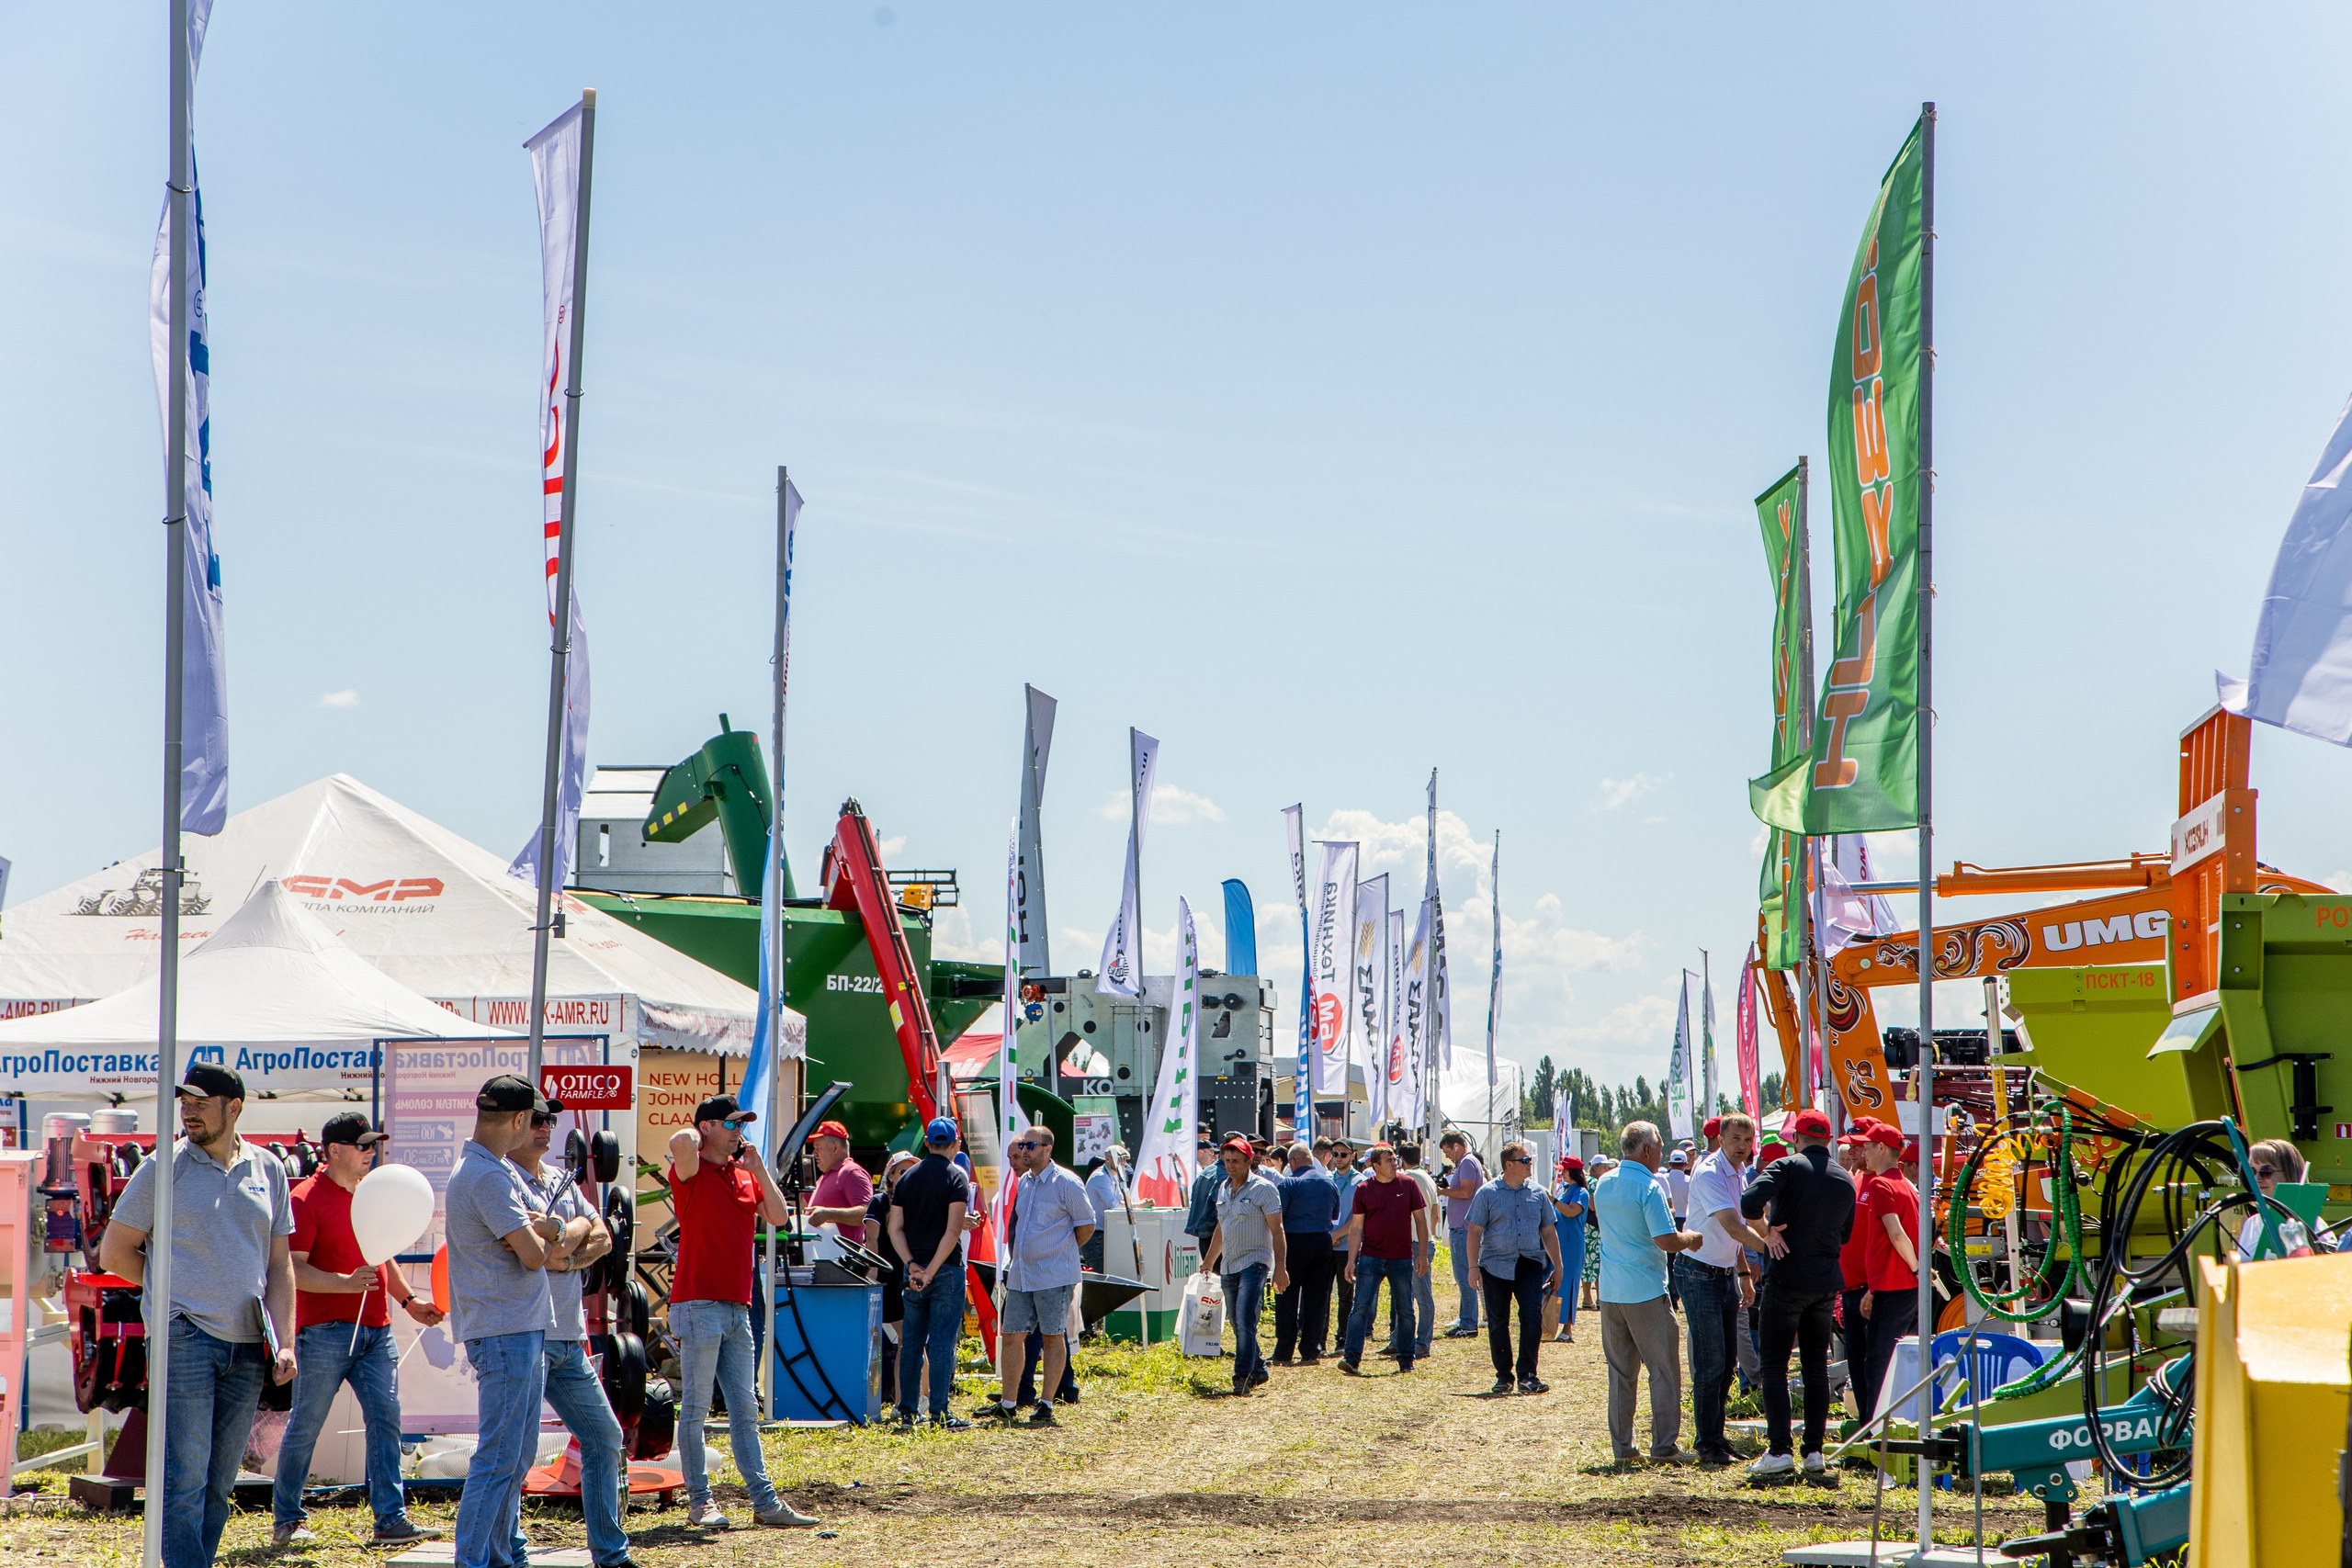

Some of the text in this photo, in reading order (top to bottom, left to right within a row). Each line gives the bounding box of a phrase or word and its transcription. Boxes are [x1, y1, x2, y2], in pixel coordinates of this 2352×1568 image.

[336, 904, 435, 914] КОМПАНИЙ
[2042, 909, 2170, 953] UMG
[826, 974, 884, 994] БП-22/2
[2085, 971, 2155, 990] ПСКТ-18
[487, 1000, 610, 1025] WWW.K-AMR.RU
[0, 1049, 160, 1079] гроПоставка
[235, 1046, 383, 1075] АгроПостав
[89, 1075, 158, 1084] Нижний Новгоро
[341, 1071, 372, 1079] Нижний
[560, 1075, 620, 1090] OTICO
[649, 1072, 741, 1086] NEW HOLL
[1082, 1078, 1114, 1096] KO
[648, 1092, 696, 1106] JOHN
[648, 1112, 694, 1125] CLAA
